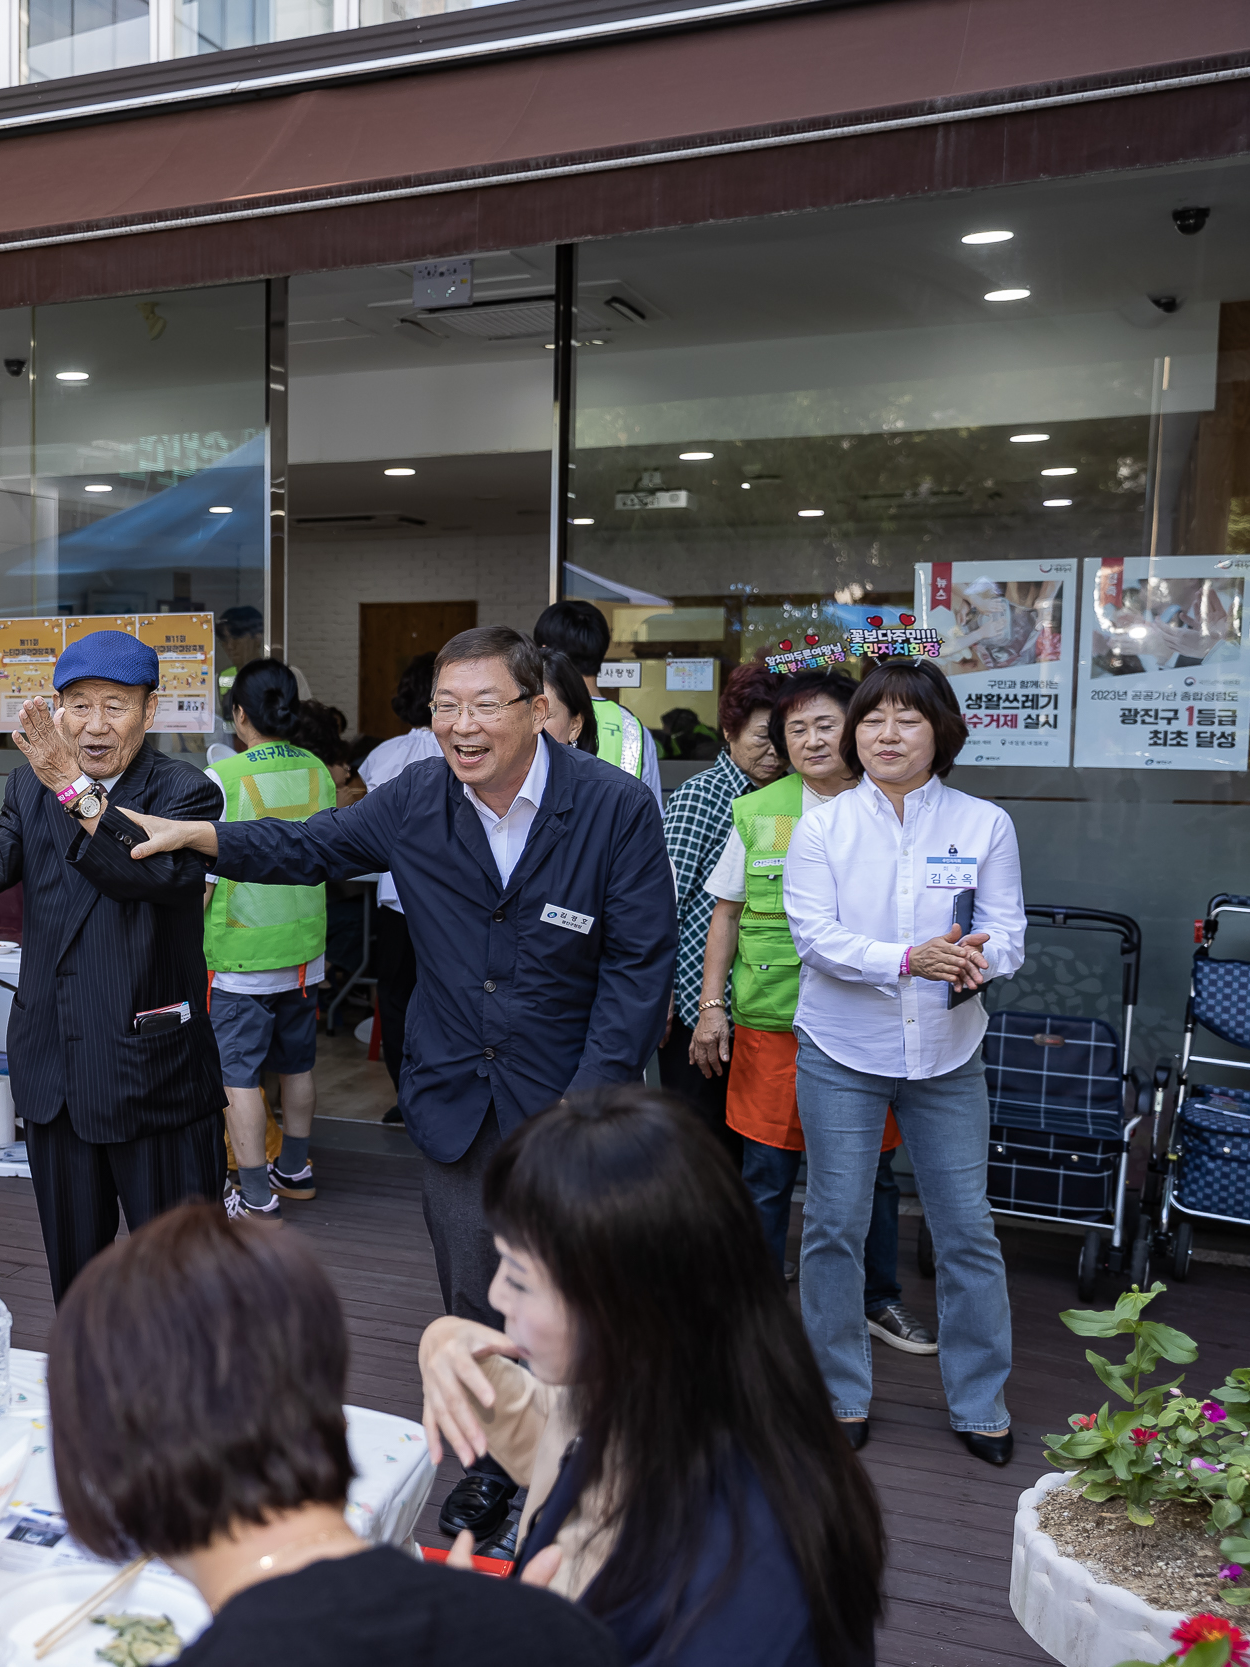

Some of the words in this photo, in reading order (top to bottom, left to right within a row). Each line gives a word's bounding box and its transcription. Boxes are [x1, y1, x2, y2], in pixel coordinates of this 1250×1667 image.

[935, 576, 948, 600] 뉴스
[850, 629, 937, 643] 꽃보다주민!!!
[765, 642, 842, 666] 앞치마두른여왕님
[850, 642, 940, 657] 주민자치회장
[768, 652, 845, 674] 자원봉사캠프단장
[987, 680, 1017, 689] 구민과
[1019, 680, 1059, 689] 함께하는
[965, 693, 1059, 710] 생활쓰레기
[1090, 690, 1128, 701] 2023년
[1131, 690, 1177, 702] 공공기관
[1023, 713, 1058, 729] 실시
[1119, 708, 1180, 726] 광진구
[1185, 705, 1238, 726] 1등급
[1148, 729, 1189, 748] 최초
[1195, 730, 1237, 748] 달성
